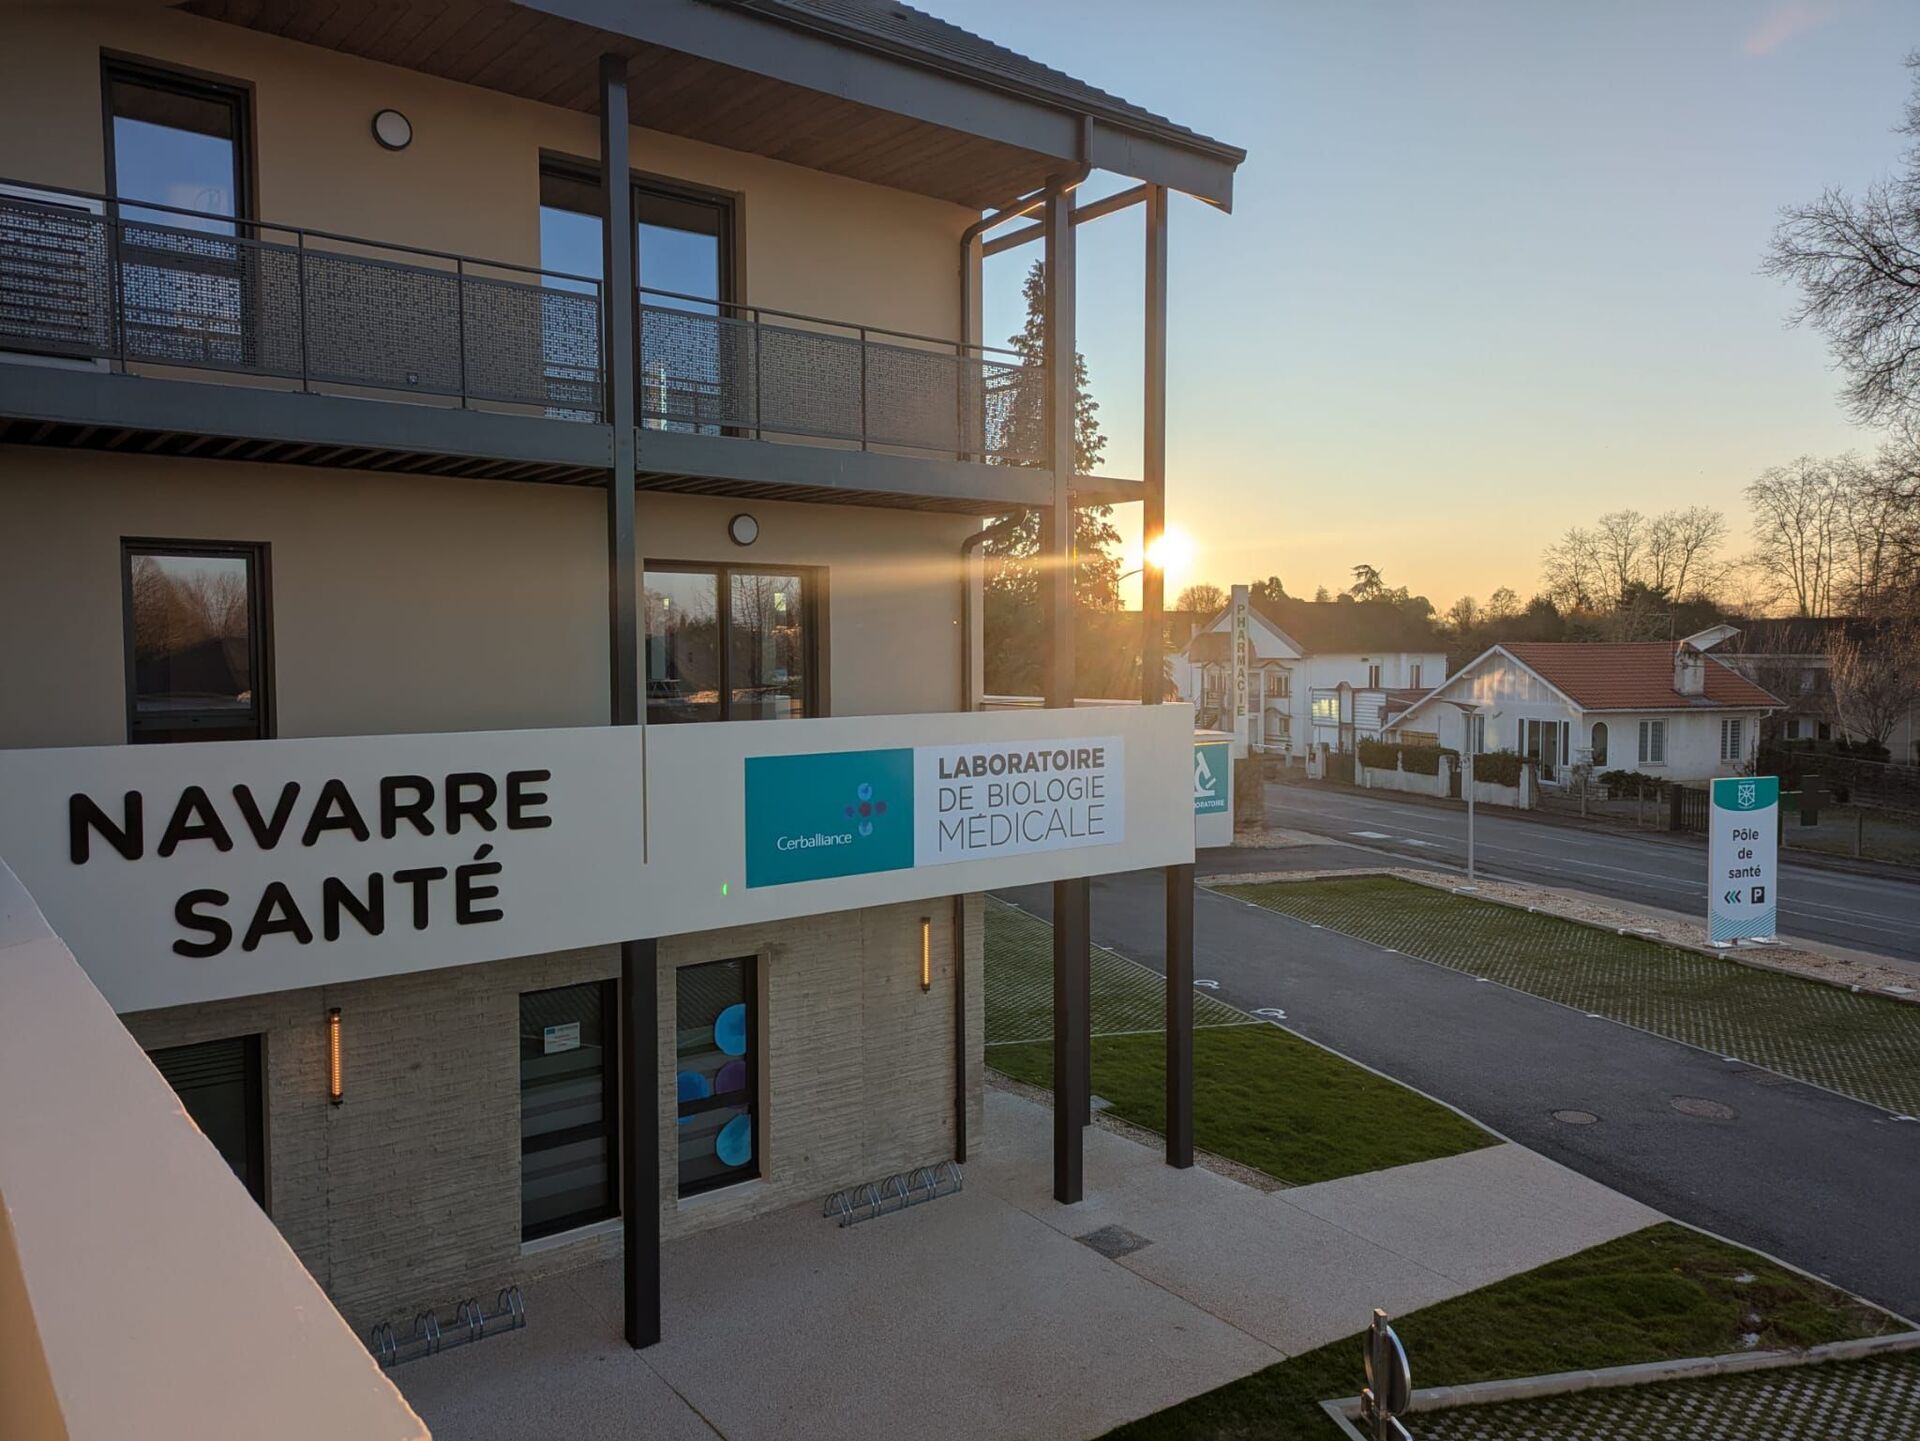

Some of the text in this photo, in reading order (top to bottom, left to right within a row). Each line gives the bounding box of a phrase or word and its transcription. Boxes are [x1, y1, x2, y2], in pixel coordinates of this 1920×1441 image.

[1236, 604, 1246, 717] PHARMACIE
[938, 747, 1105, 780] LABORATOIRE
[938, 775, 1105, 813] DE BIOLOGIE
[69, 769, 552, 865] NAVARRE
[938, 804, 1105, 852] MÉDICALE
[1732, 828, 1759, 841] Pôle
[777, 833, 852, 851] Cerballiance
[1737, 847, 1753, 860] de
[1728, 864, 1762, 879] santé
[172, 843, 504, 959] SANTÉ
